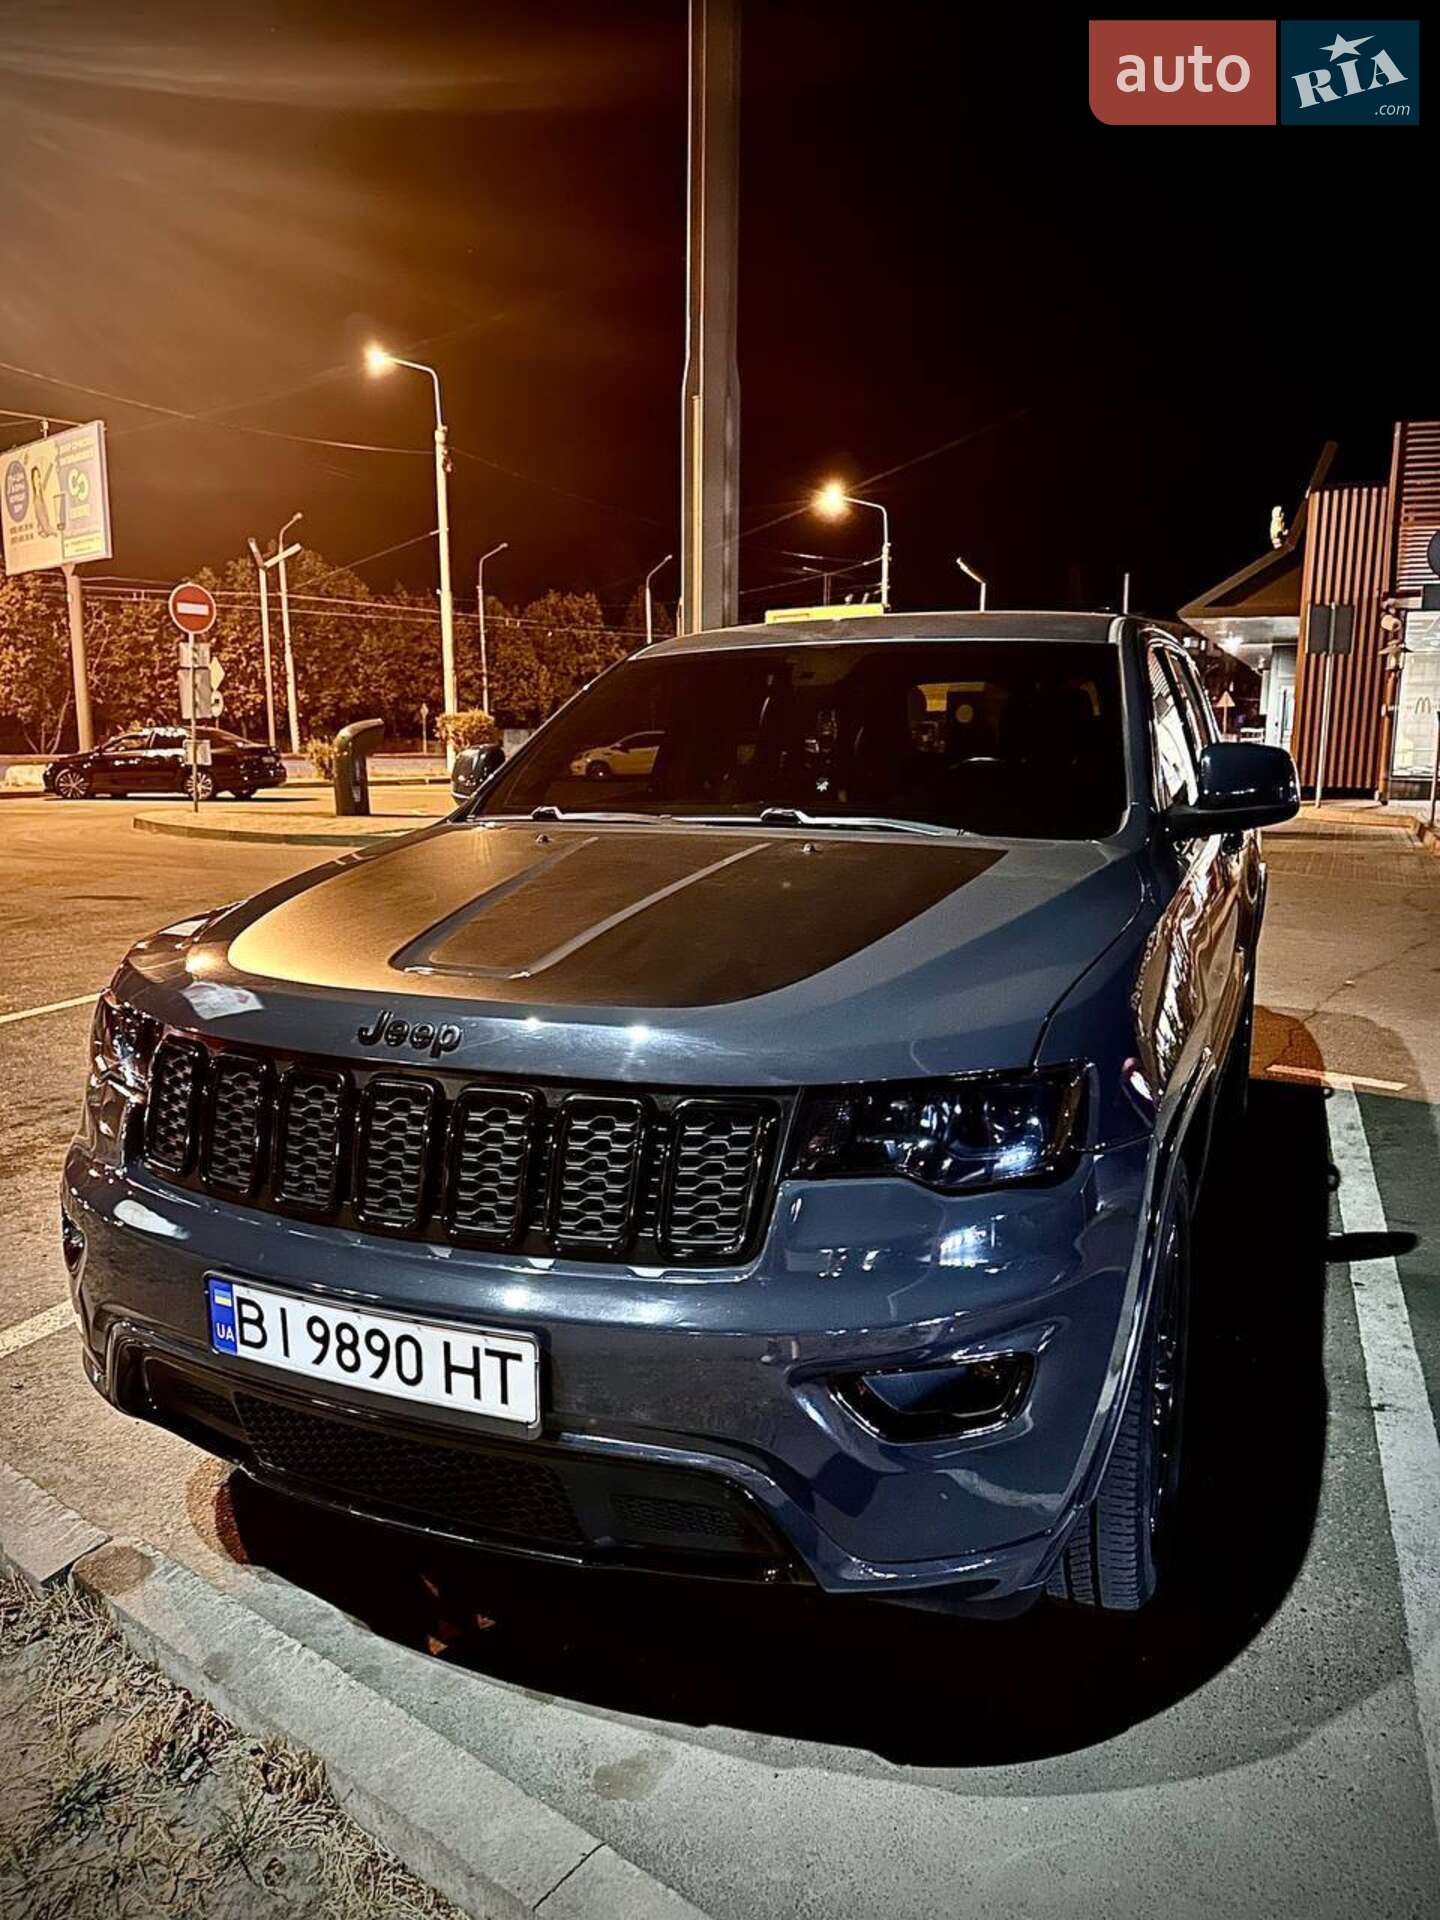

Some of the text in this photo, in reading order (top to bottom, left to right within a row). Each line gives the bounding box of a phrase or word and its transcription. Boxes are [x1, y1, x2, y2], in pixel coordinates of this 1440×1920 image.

[358, 1009, 463, 1059] Jeep
[216, 1322, 236, 1343] UA
[236, 1296, 522, 1406] BI 9890 HT
